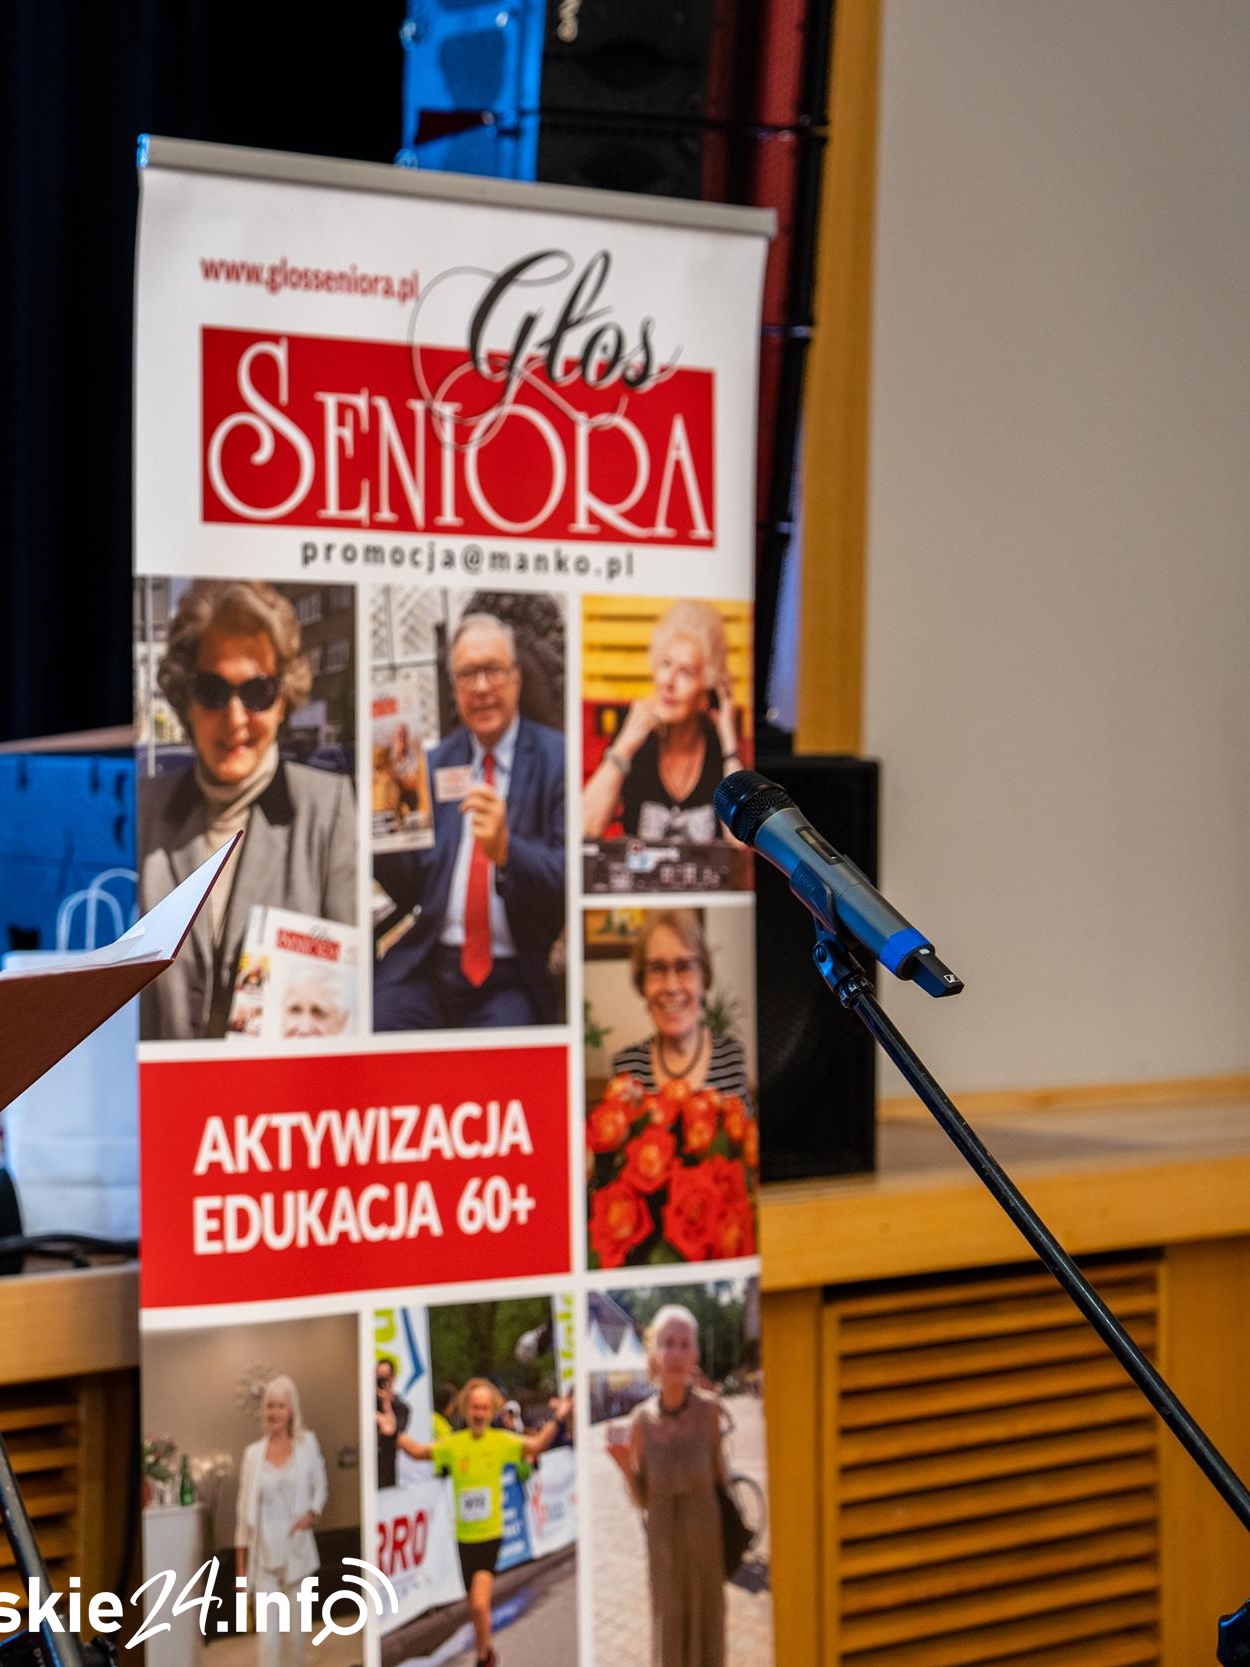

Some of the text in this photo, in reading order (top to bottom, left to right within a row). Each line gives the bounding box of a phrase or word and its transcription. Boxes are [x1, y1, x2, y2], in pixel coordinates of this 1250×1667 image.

[200, 256, 419, 304] www.glosseniora.pl
[207, 338, 714, 541] SENIORA
[300, 540, 634, 579] promocja@manko.pl
[193, 1099, 534, 1176] AKTYWIZACJA
[193, 1175, 536, 1256] EDUKACJA 60+
